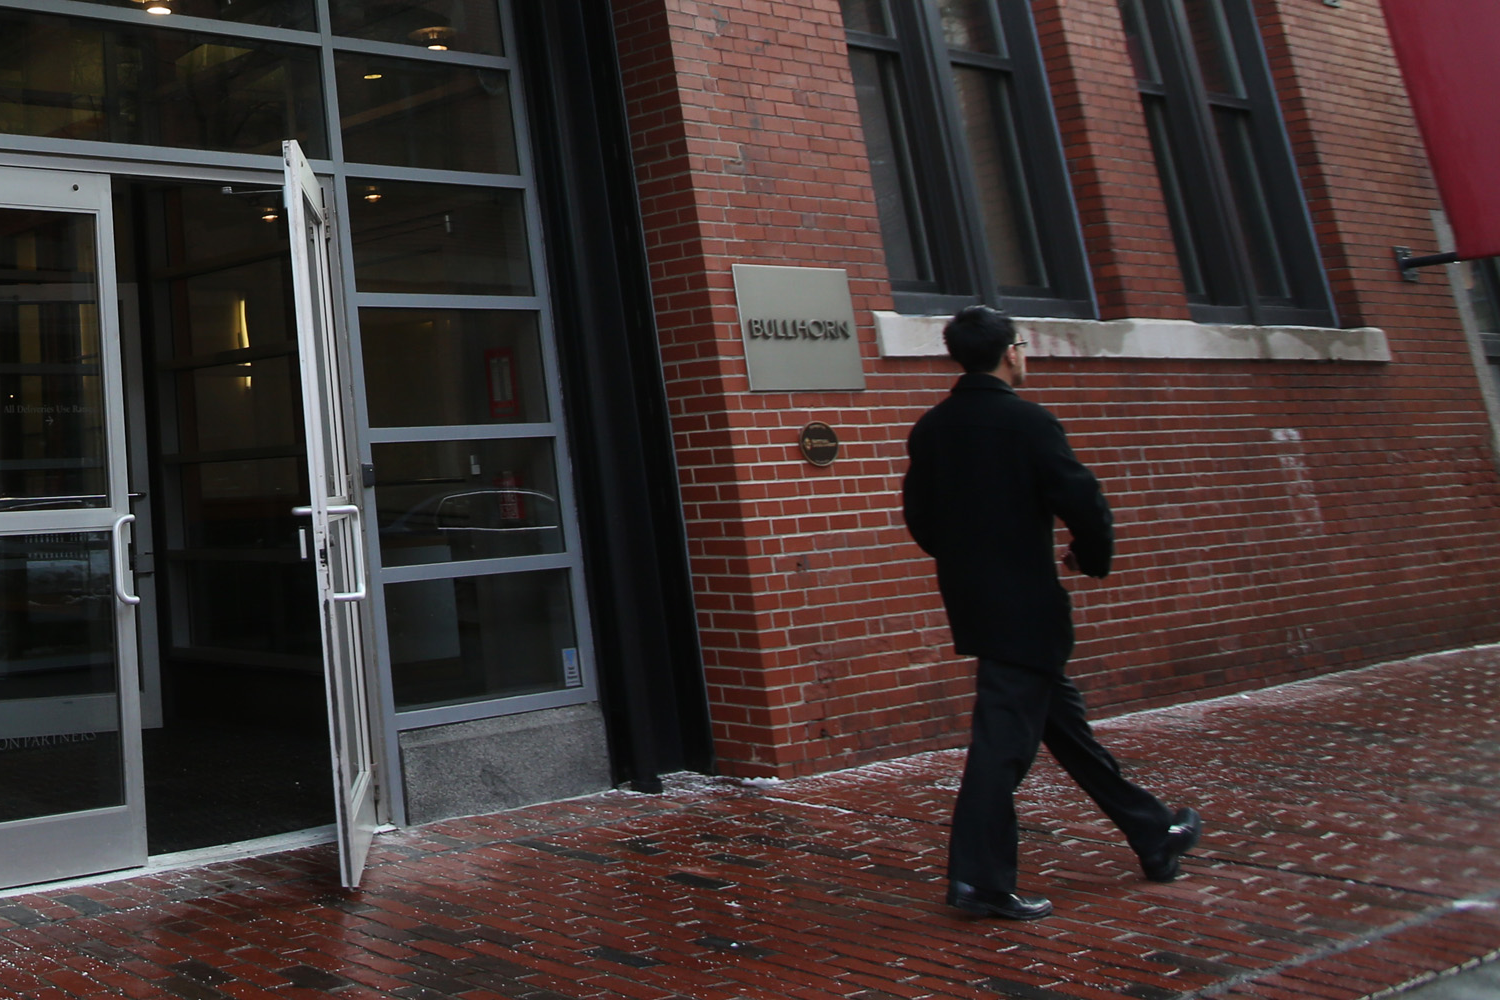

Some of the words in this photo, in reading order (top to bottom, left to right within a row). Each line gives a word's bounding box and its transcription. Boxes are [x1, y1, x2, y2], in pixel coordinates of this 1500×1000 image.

[748, 319, 850, 339] BULLHORN
[3, 405, 15, 414] All
[17, 404, 53, 414] Deliveries
[56, 405, 70, 414] Use
[24, 730, 97, 748] PARTNERS
